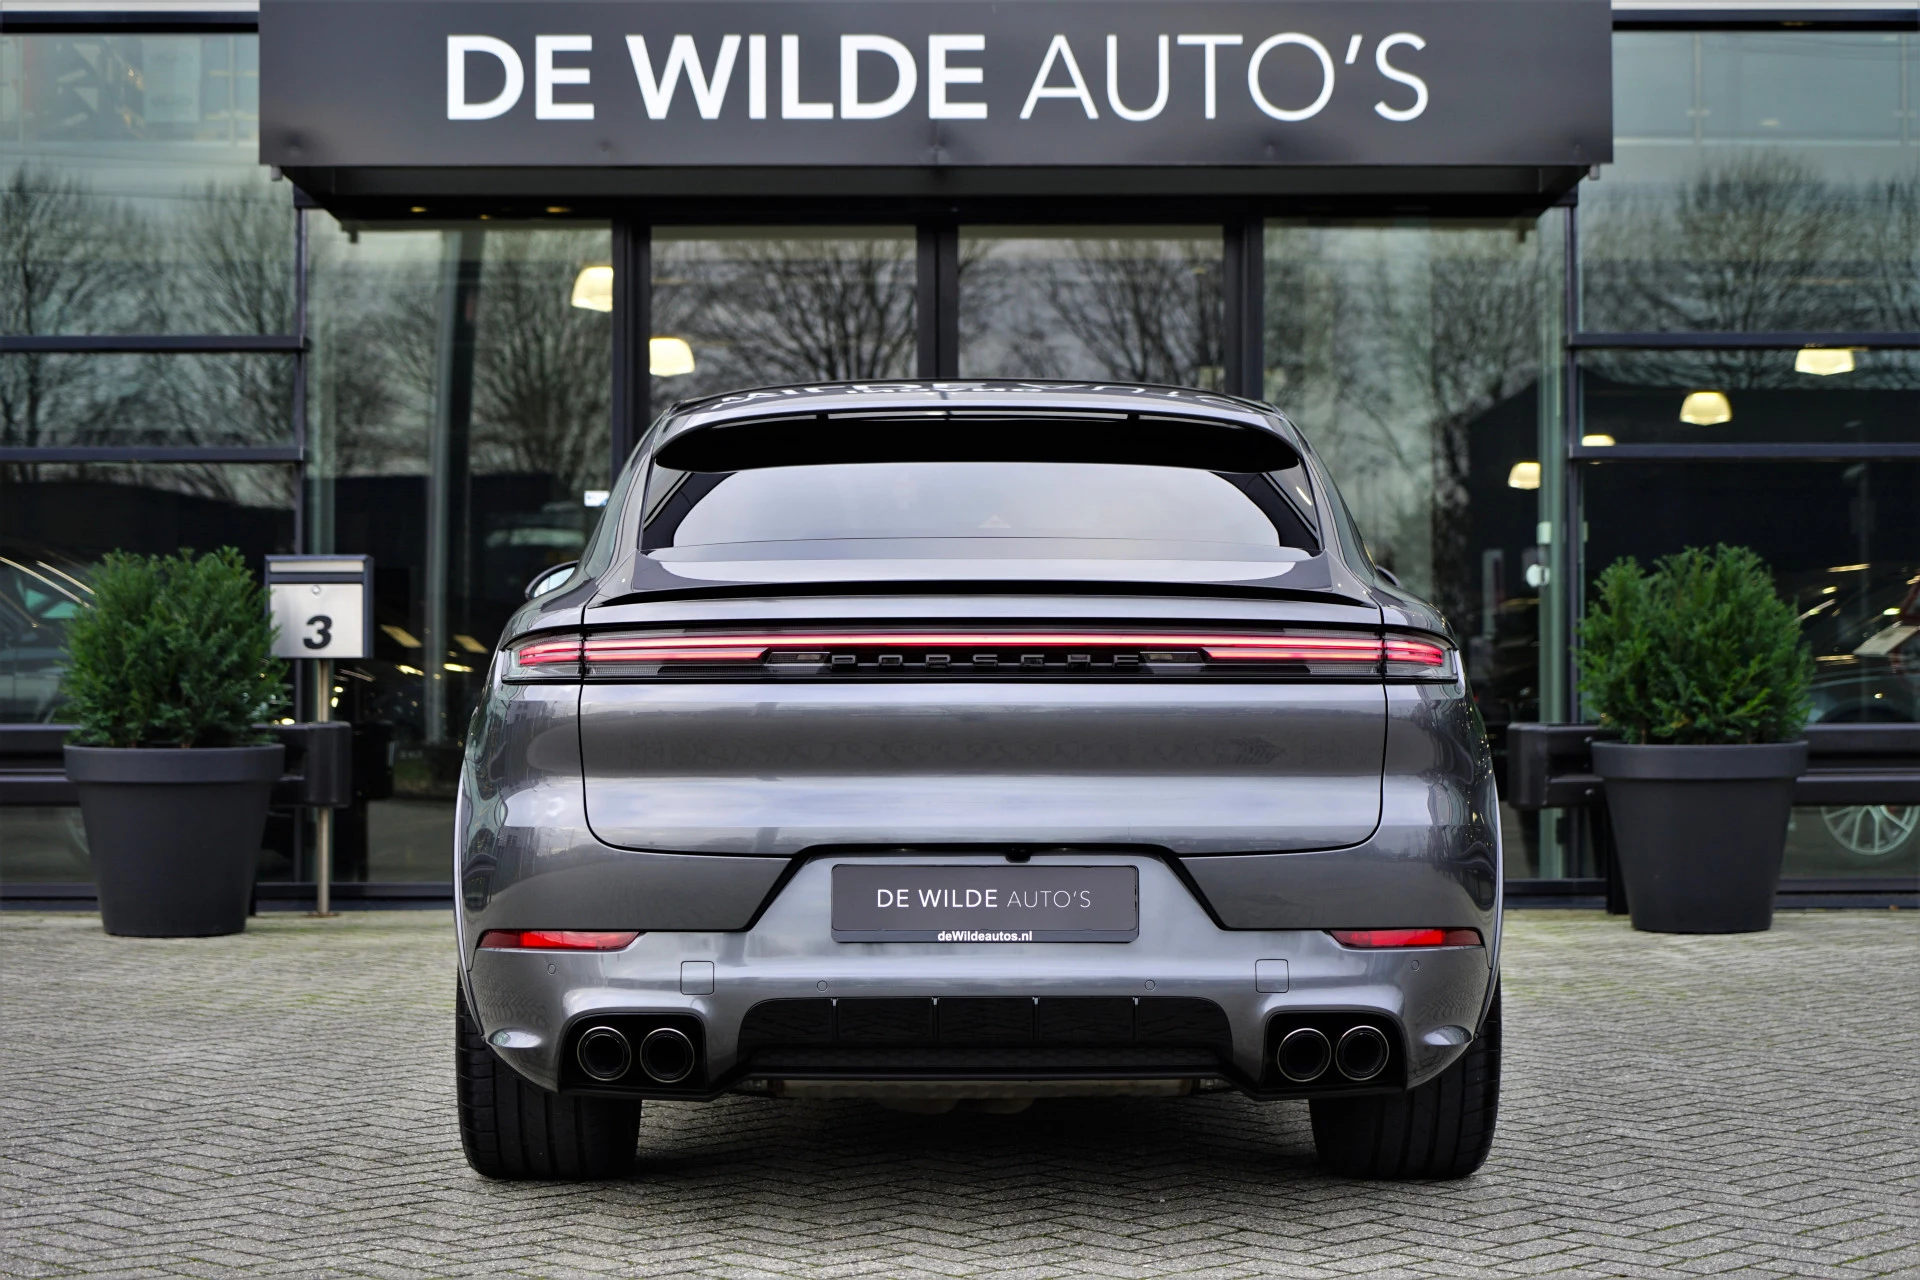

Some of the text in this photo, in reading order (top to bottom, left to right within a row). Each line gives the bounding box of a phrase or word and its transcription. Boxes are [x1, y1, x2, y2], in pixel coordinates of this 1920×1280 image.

[446, 33, 1429, 121] DE WILDE AUTO'S
[302, 615, 332, 650] 3
[831, 654, 1140, 668] PORSCHE
[877, 889, 1091, 908] DE WILDE AUTO'S
[937, 931, 1033, 942] deWildeautos.nl
